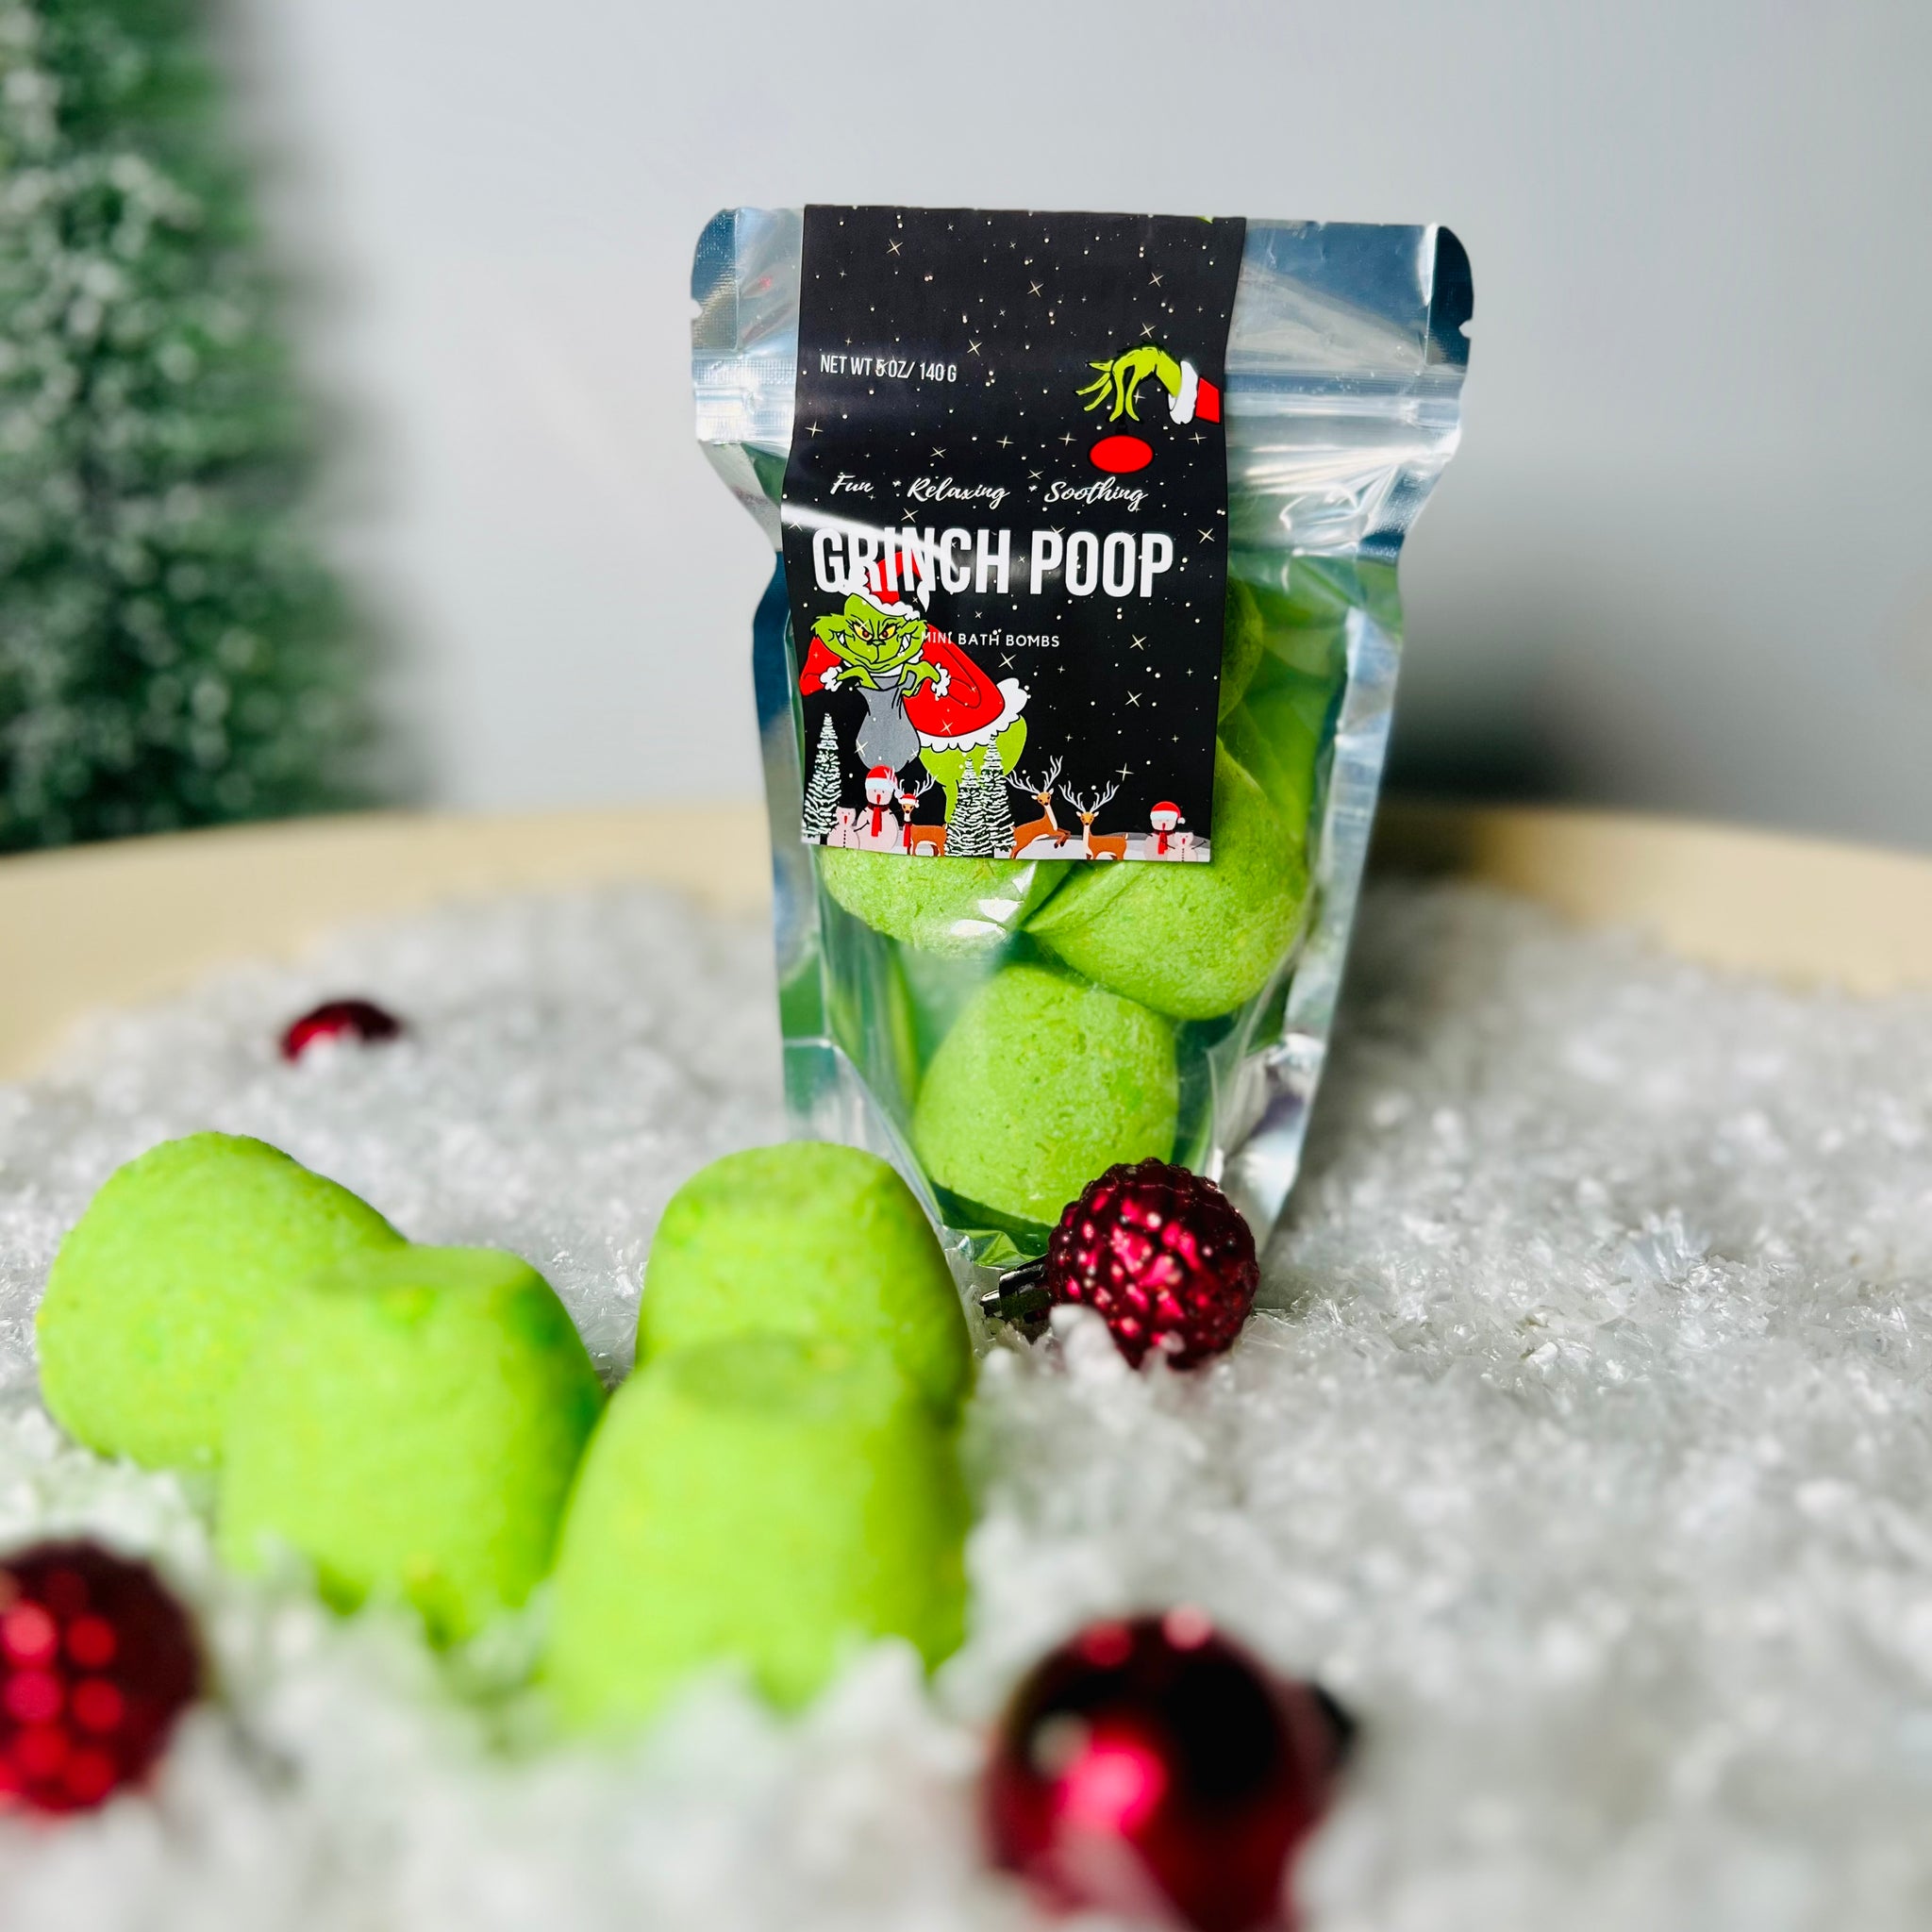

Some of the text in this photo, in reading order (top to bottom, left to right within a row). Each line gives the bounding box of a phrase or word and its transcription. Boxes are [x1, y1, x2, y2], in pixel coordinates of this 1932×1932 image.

[820, 355, 847, 375] NET
[850, 357, 874, 376] WT
[875, 359, 885, 376] 5
[920, 362, 945, 381] 140
[947, 364, 958, 383] G
[830, 474, 1149, 512] Fun Relaxing Soothing
[812, 526, 1174, 598] GRINCH POOP
[922, 631, 1060, 648] MINI BATH BOMBS
